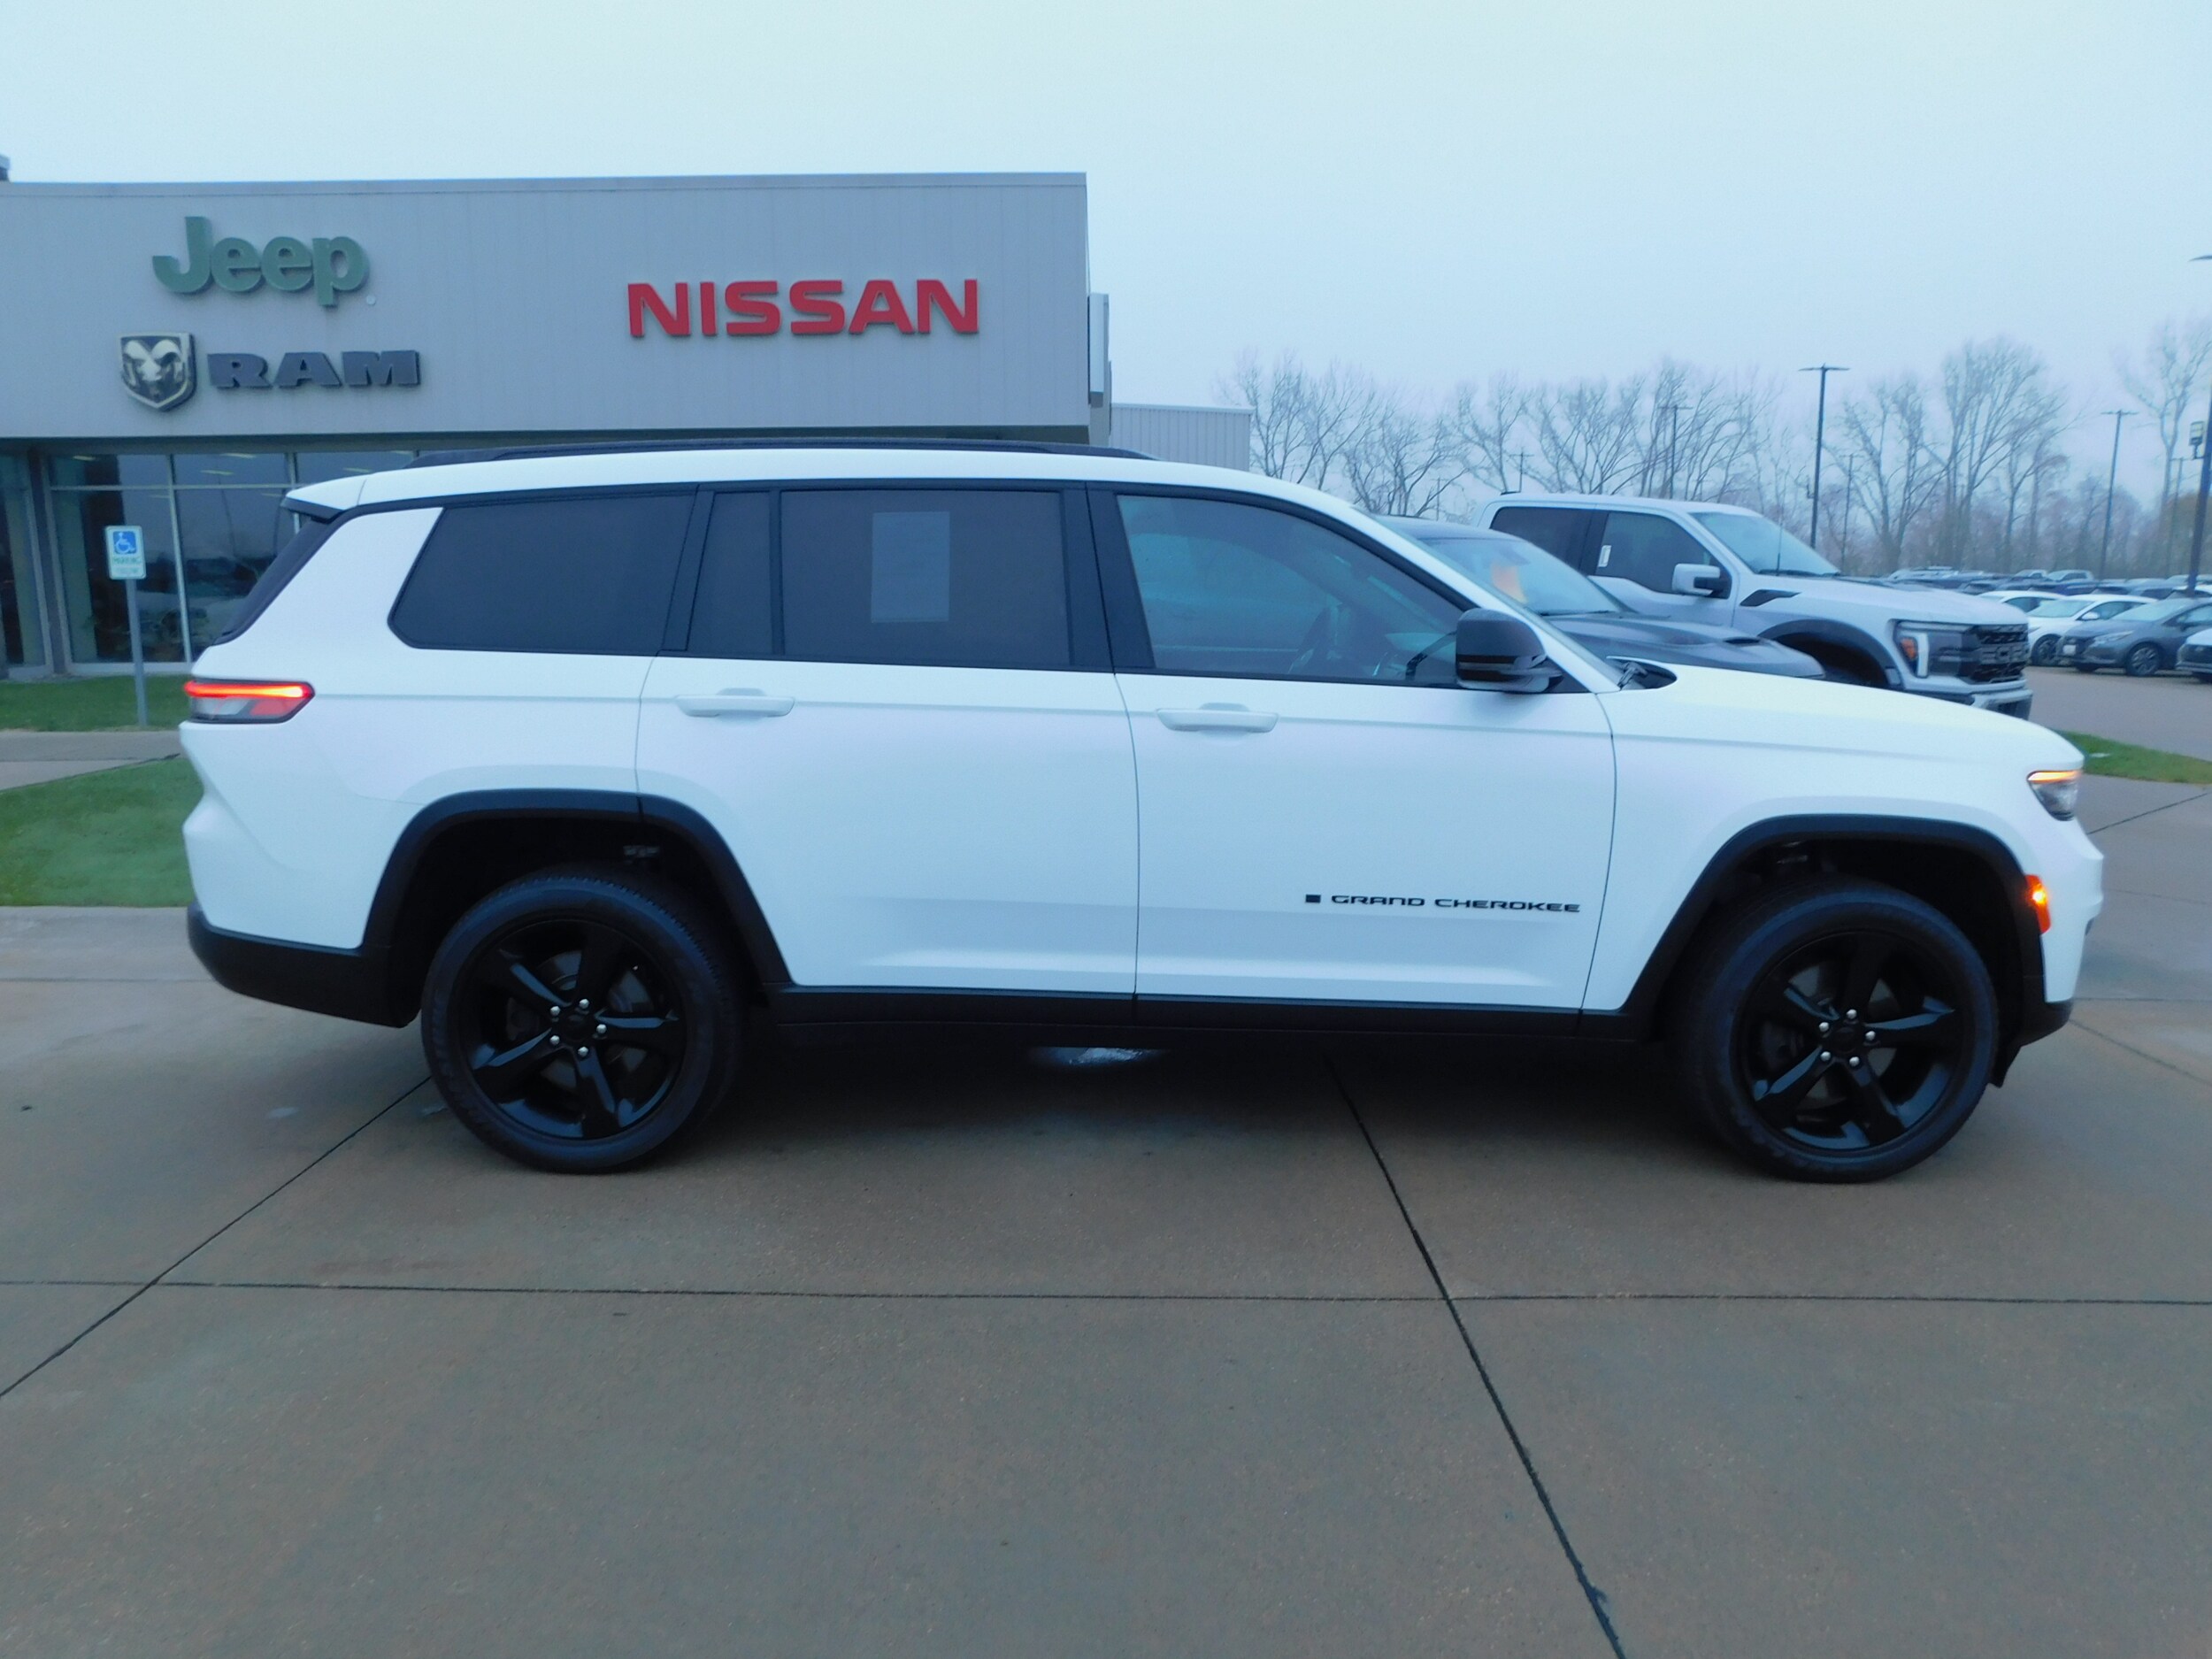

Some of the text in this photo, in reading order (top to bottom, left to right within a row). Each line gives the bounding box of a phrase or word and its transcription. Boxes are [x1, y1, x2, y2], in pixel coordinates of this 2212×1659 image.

[152, 216, 370, 308] Jeep
[627, 279, 979, 337] NISSAN
[207, 350, 420, 388] RAM
[1331, 895, 1580, 912] GRAND CHEROKEE
